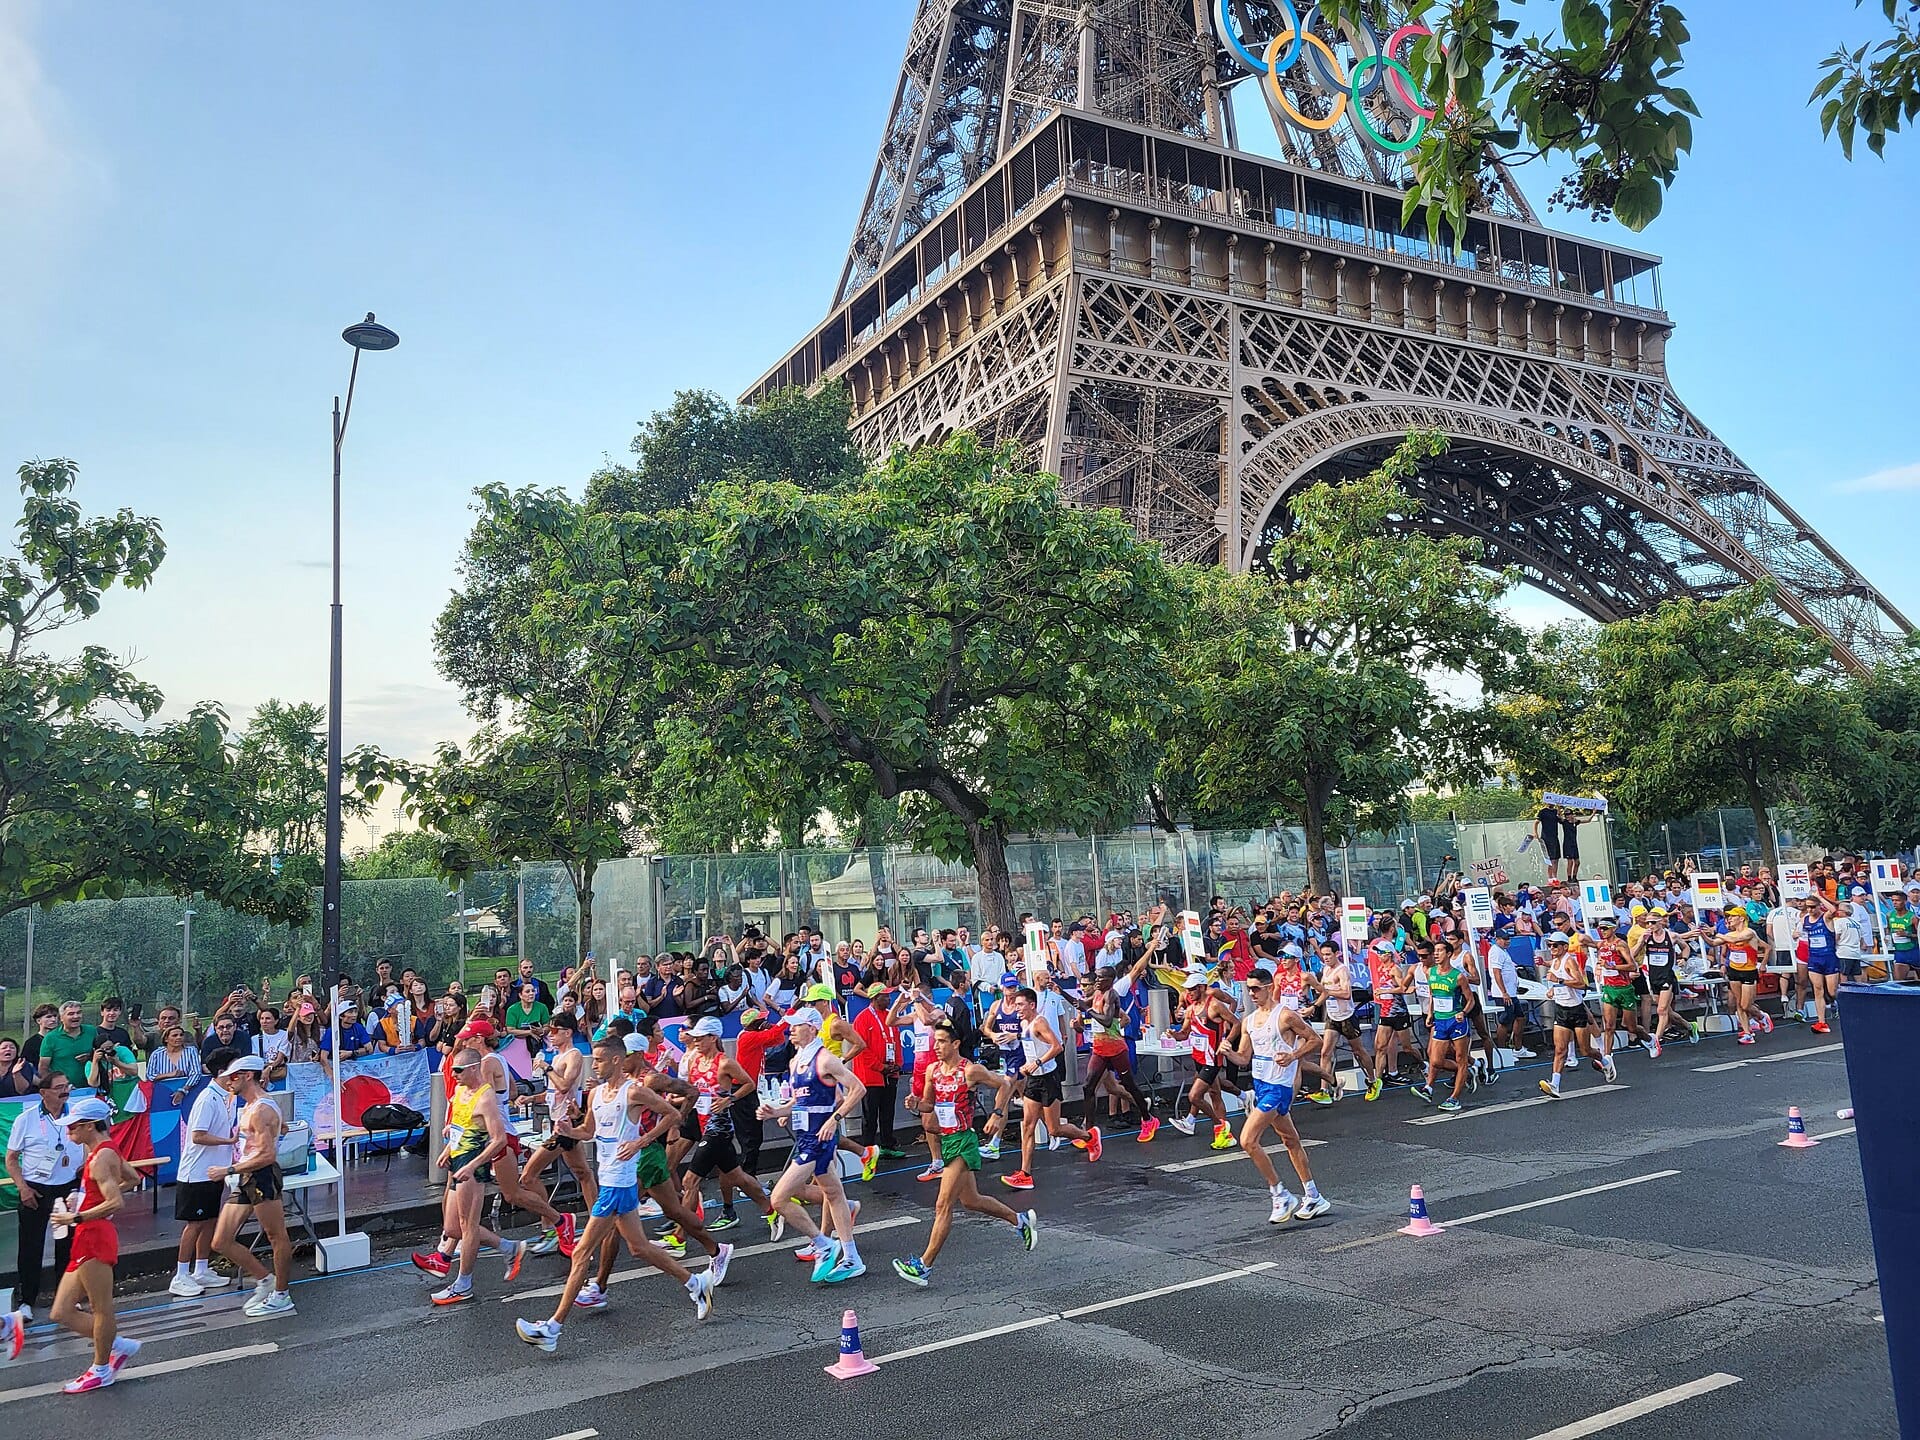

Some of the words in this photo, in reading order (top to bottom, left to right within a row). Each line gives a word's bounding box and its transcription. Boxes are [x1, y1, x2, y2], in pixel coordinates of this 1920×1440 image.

[1078, 251, 1103, 264] SEGUIN
[1117, 260, 1142, 272] ALANDE
[1476, 859, 1500, 872] ALLEZ
[1431, 983, 1450, 992] BRASIL
